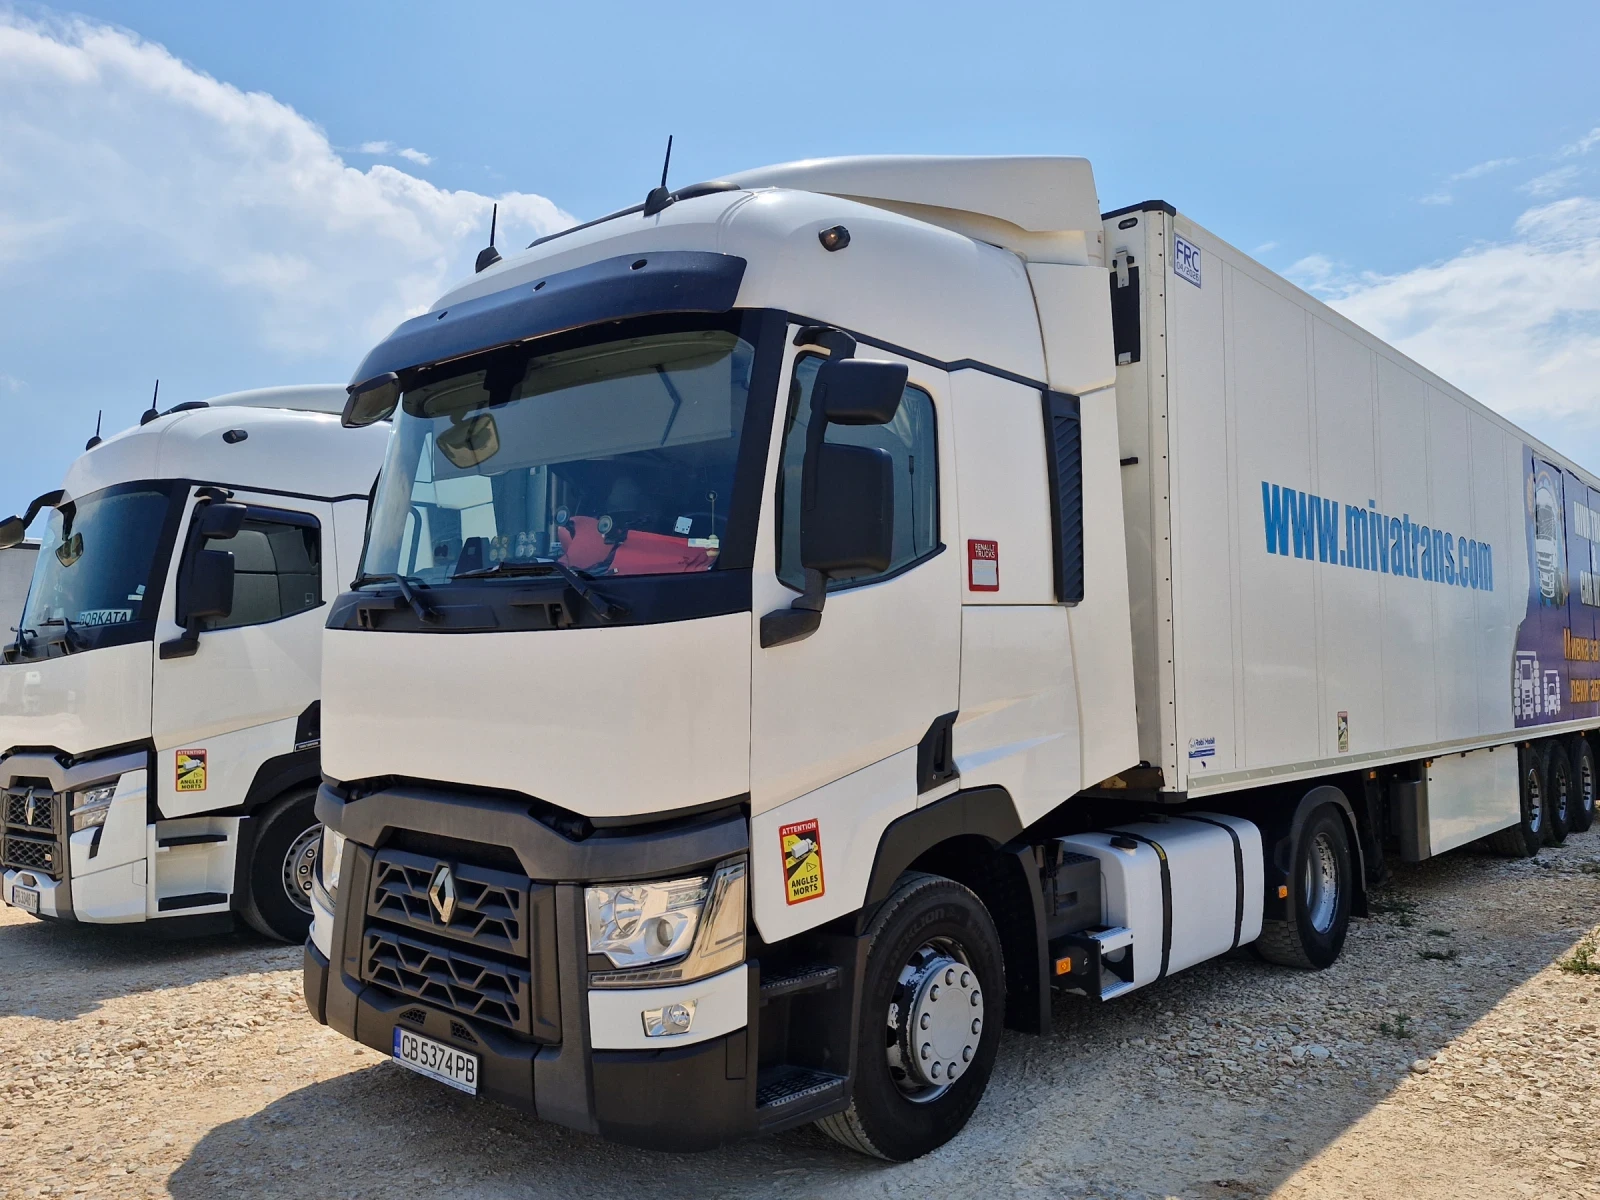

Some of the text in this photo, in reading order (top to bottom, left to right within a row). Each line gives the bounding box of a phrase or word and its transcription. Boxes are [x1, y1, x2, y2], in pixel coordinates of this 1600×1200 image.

[1176, 240, 1199, 273] FRC
[1261, 480, 1493, 592] www.mivatrans.com
[974, 543, 995, 552] RENAULT
[975, 550, 996, 559] TRUCKS
[79, 611, 128, 626] BORKATA
[1563, 626, 1590, 662] Мивка
[1570, 677, 1589, 703] леки
[782, 821, 816, 835] ATTENTION
[791, 874, 818, 888] ANGLES
[793, 883, 818, 896] MORTS
[402, 1034, 418, 1061] CB
[420, 1041, 453, 1076] 5374
[455, 1054, 475, 1083] PB
